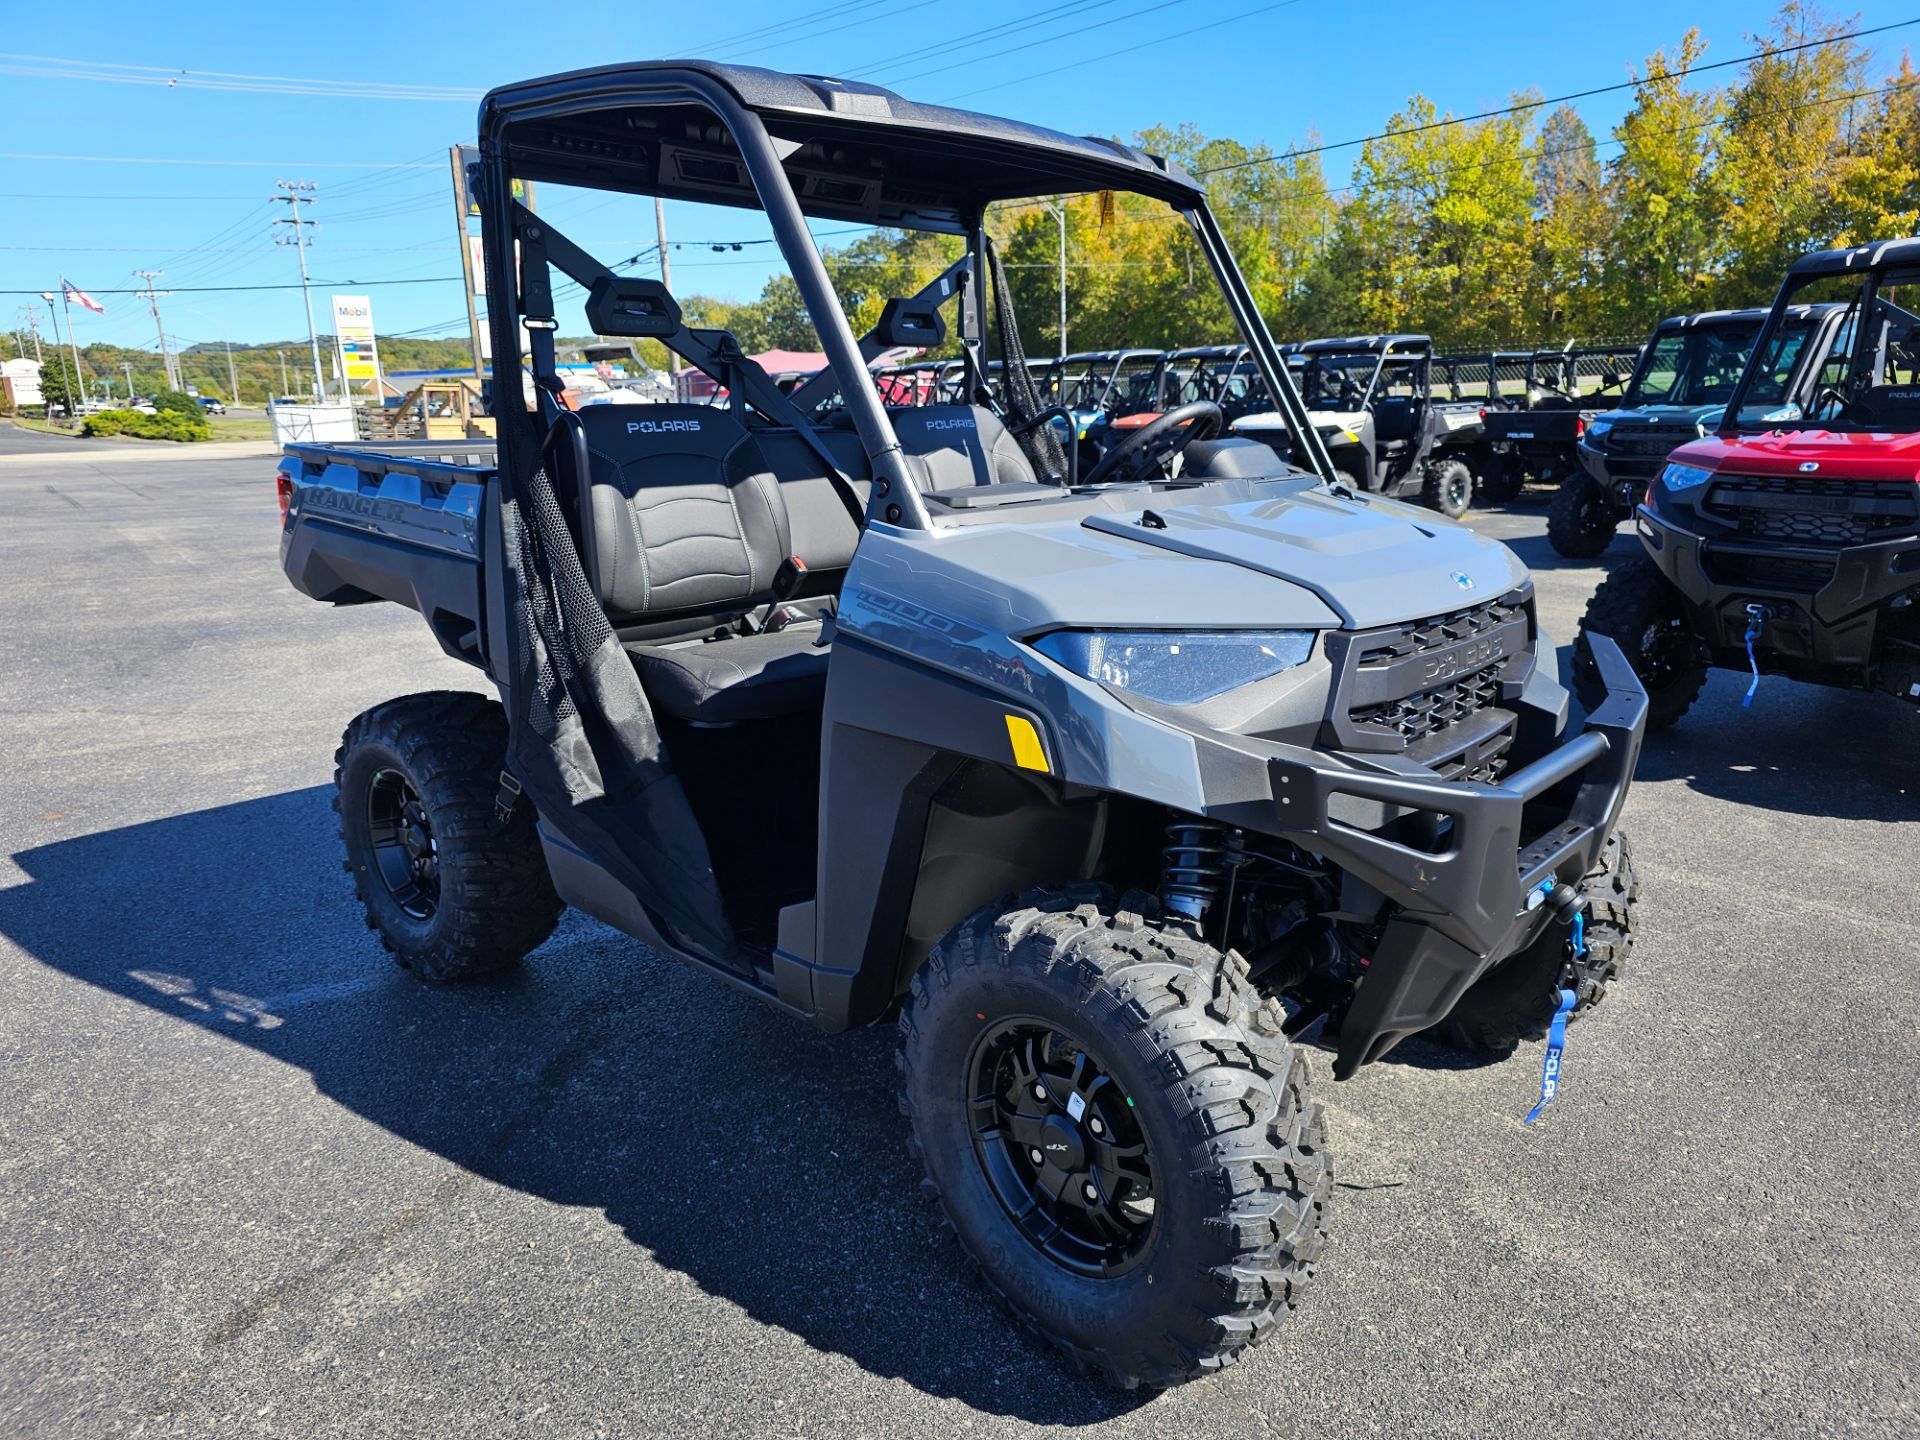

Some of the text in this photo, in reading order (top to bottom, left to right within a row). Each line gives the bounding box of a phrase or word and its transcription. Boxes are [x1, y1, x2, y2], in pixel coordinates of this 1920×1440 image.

[338, 306, 368, 317] Mobil
[626, 420, 701, 434] POLARIS
[925, 419, 976, 431] POLARIS
[303, 487, 405, 523] RANGER
[1422, 638, 1504, 686] POLARIS
